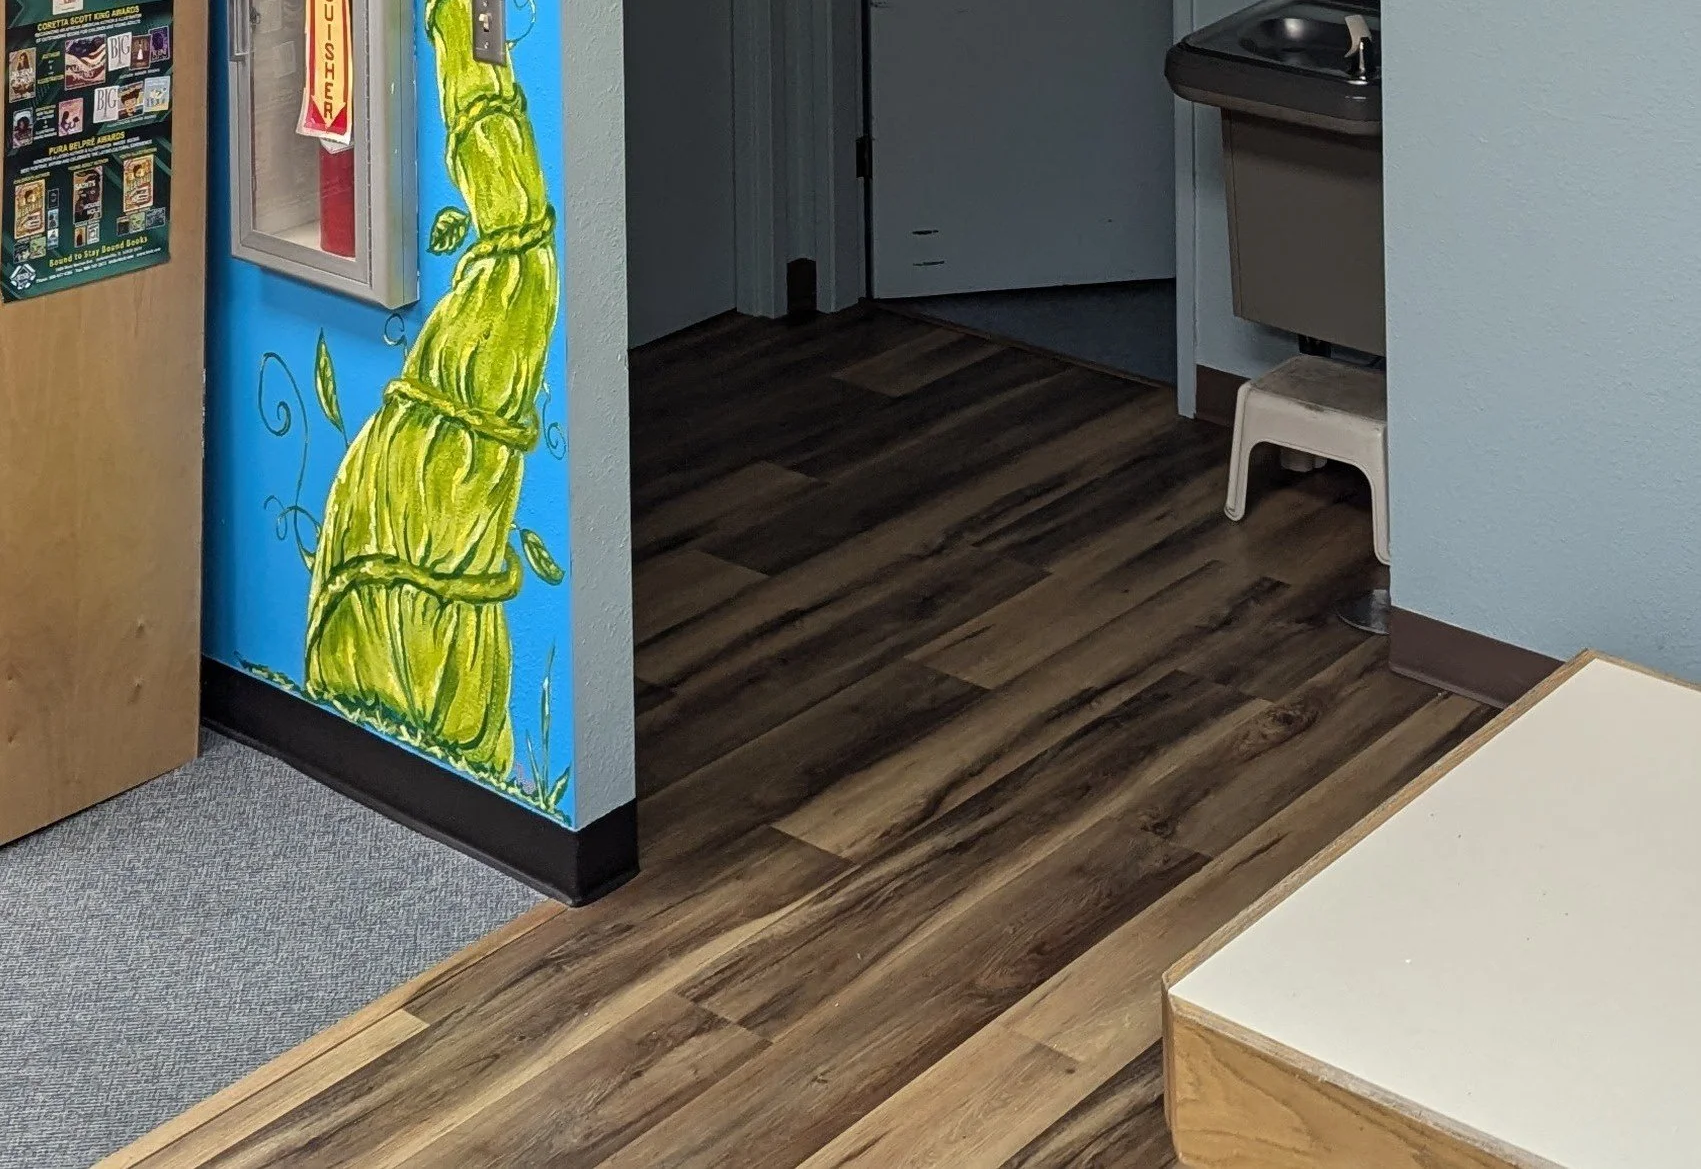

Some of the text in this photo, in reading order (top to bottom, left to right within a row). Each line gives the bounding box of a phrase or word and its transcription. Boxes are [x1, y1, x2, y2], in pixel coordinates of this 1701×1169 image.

[37, 18, 69, 31] CORETTA
[70, 14, 92, 25] SCOTT
[94, 11, 110, 20] KING
[111, 5, 140, 17] AWARDS
[111, 34, 130, 60] BIG
[97, 88, 117, 112] BIG
[49, 144, 68, 156] PURA
[97, 131, 125, 144] AWARDS
[49, 254, 72, 267] Bound
[74, 252, 82, 260] to
[83, 249, 100, 259] Stay
[101, 241, 124, 253] Bound
[126, 236, 148, 247] Books
